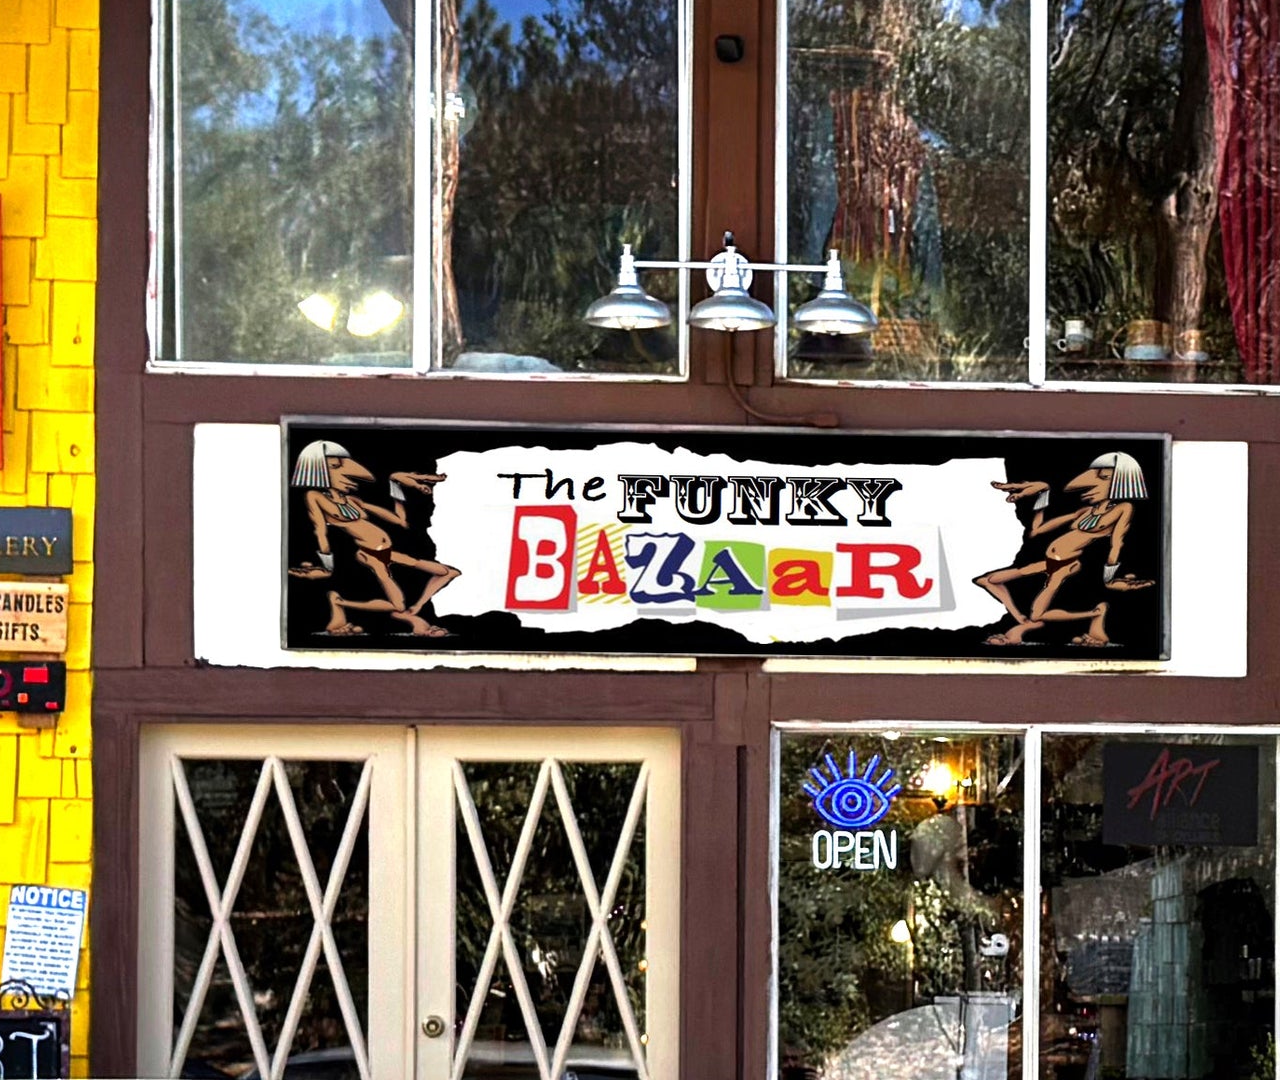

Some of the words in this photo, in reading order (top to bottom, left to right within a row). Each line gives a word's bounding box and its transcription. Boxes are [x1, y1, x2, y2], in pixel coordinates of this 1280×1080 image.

[497, 468, 607, 503] The
[617, 474, 903, 526] FUNKY
[1126, 747, 1222, 821] ART
[812, 829, 898, 870] OPEN
[11, 886, 84, 909] NOTICE
